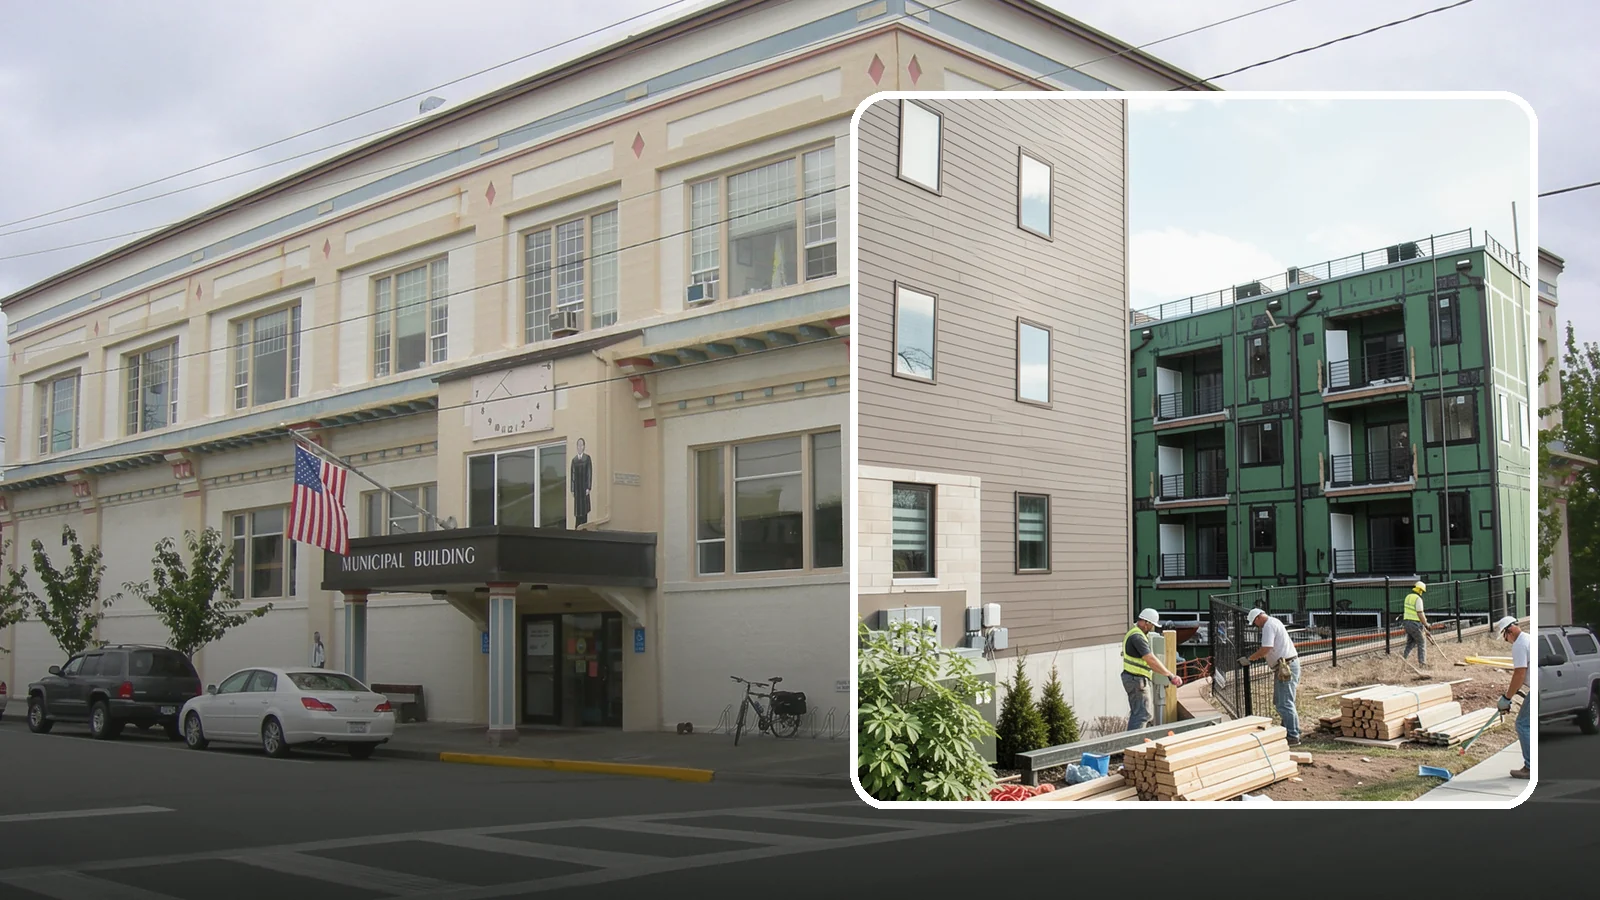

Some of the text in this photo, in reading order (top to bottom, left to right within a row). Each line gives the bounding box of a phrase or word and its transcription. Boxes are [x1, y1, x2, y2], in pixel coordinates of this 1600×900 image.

[529, 414, 533, 422] 3
[342, 546, 474, 572] MUNICIPAL BUILDING
